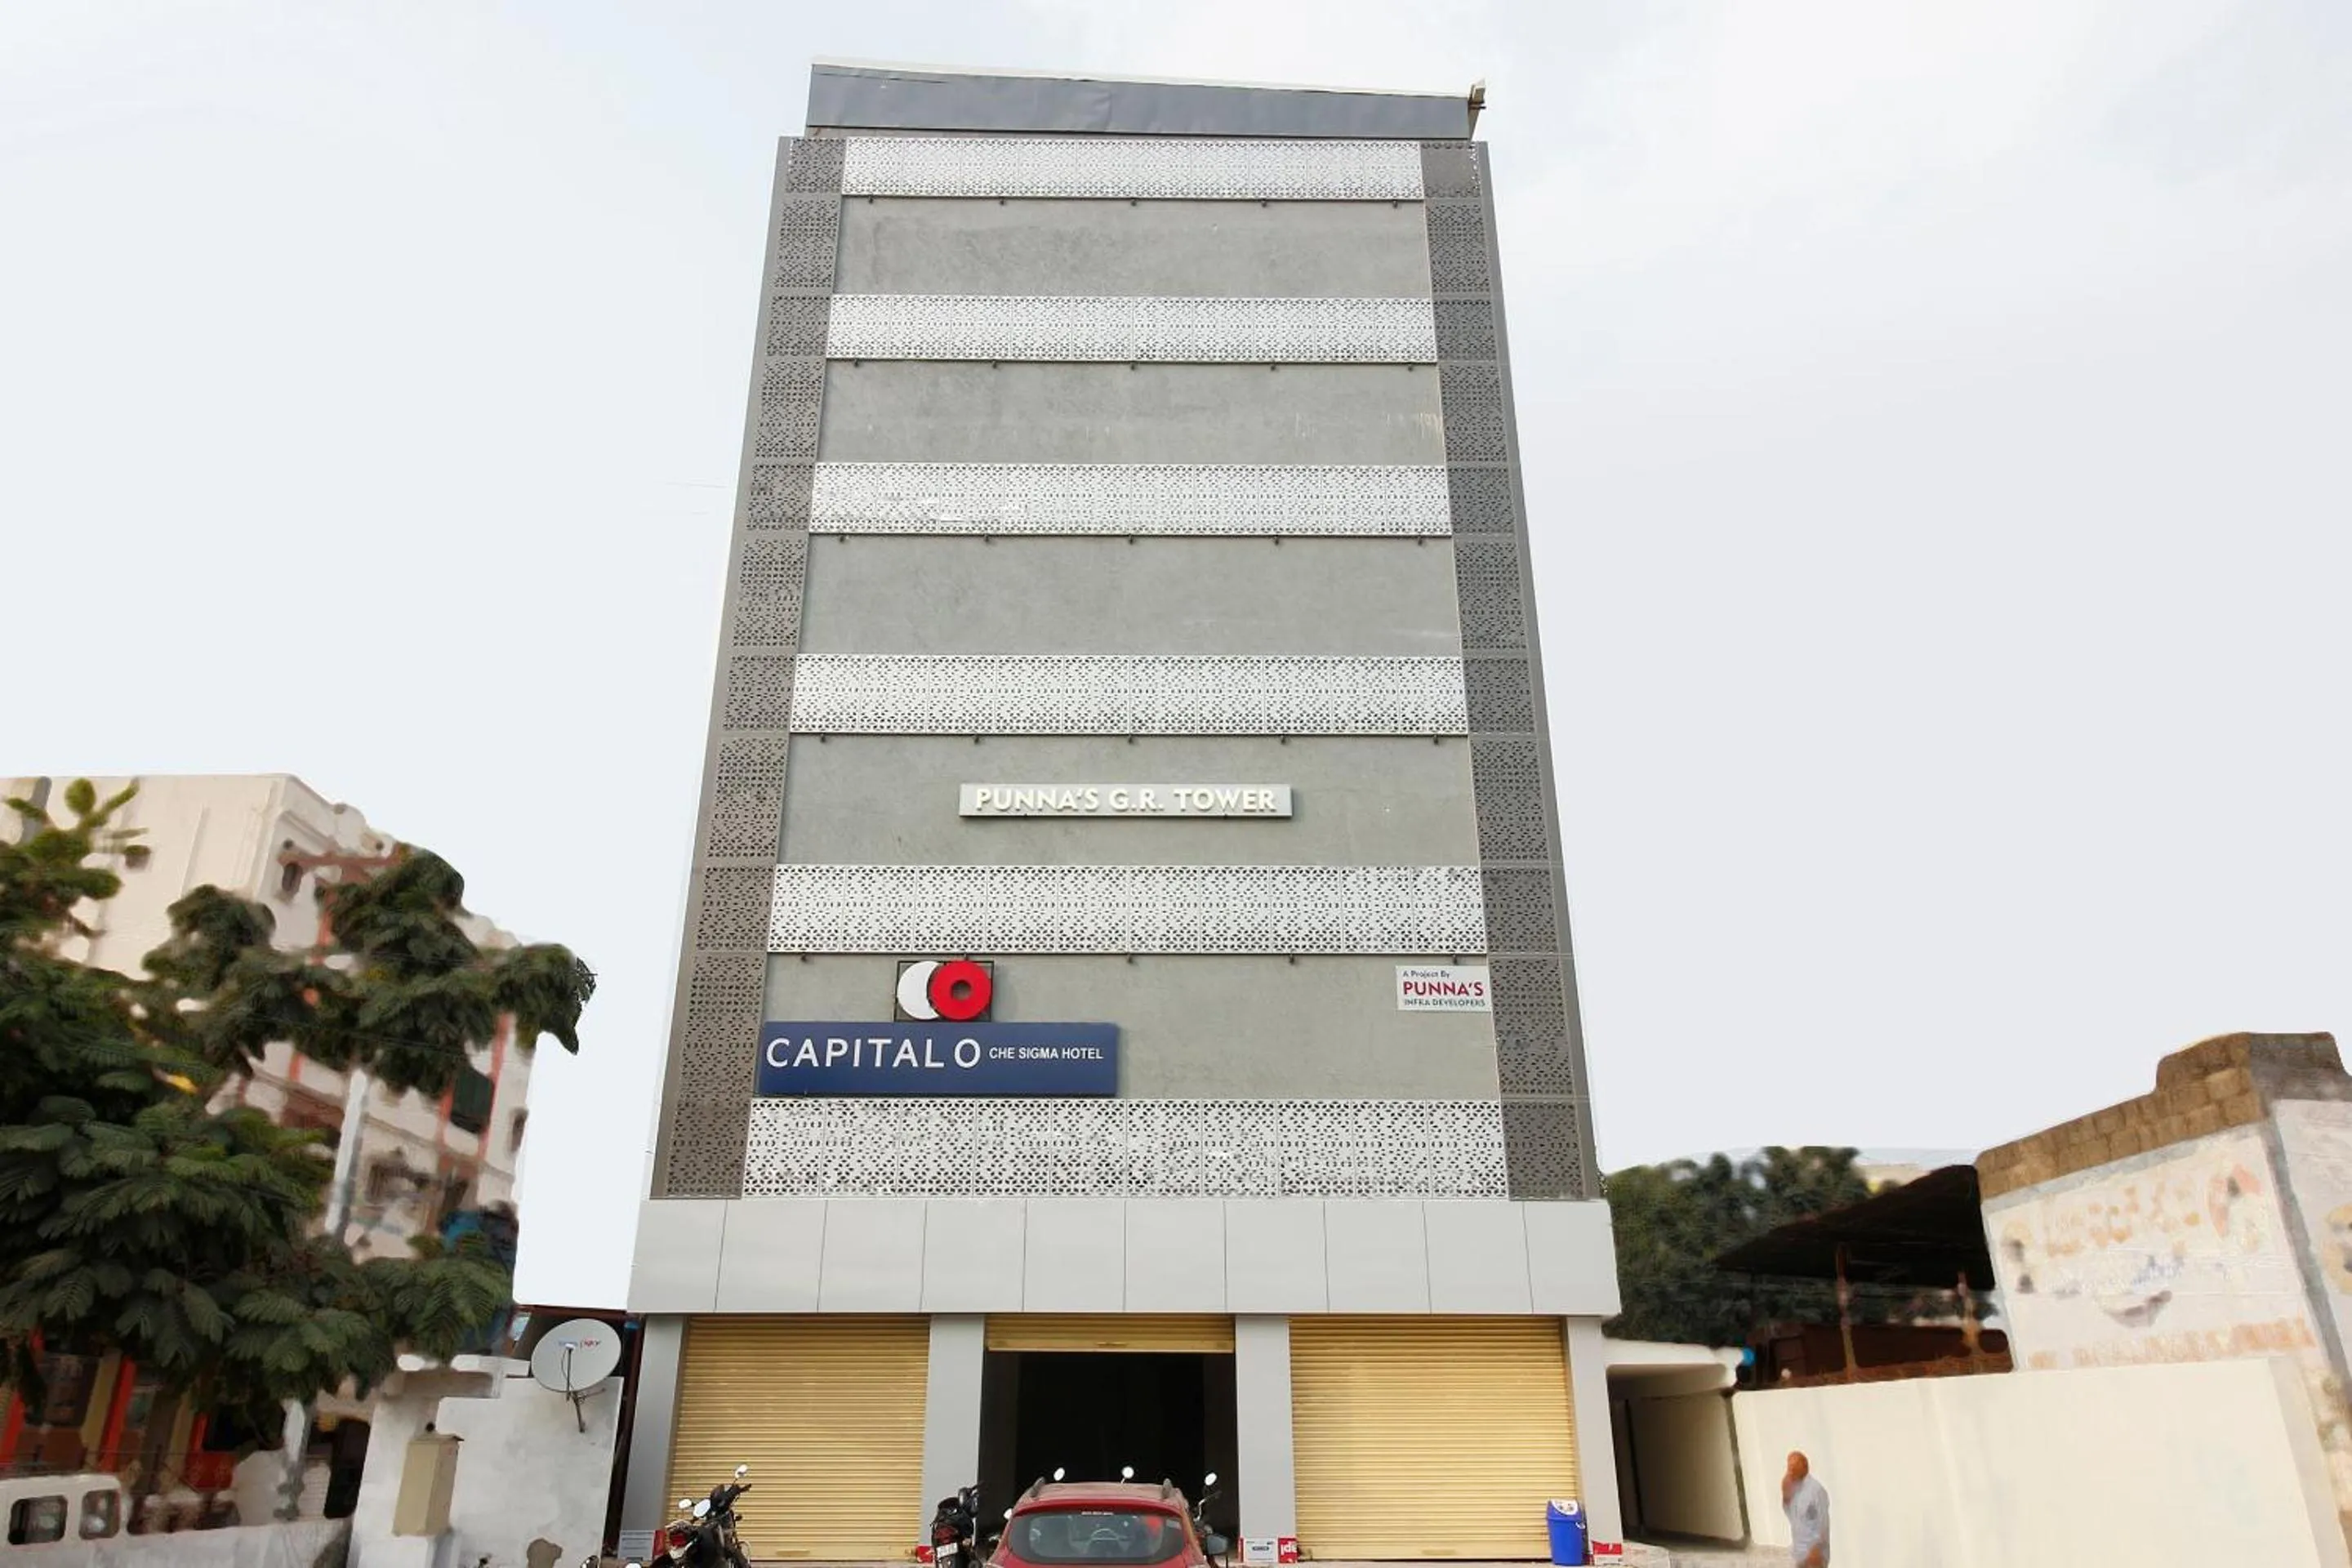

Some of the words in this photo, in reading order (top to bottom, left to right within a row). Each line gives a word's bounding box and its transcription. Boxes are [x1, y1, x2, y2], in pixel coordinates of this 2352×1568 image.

[975, 788, 1099, 811] PUNNA'S
[1108, 788, 1165, 812] G.R.
[1174, 789, 1277, 813] TOWER
[1410, 970, 1438, 978] Project
[1403, 981, 1484, 996] PUNNA'S
[1404, 998, 1431, 1006] INFRA
[1432, 998, 1486, 1007] DEVELOPERS
[765, 1038, 945, 1068] CAPITAL
[954, 1038, 981, 1068] O
[988, 1046, 1015, 1060] CHE
[1018, 1046, 1059, 1060] SIGMA
[1062, 1047, 1104, 1060] HOTEL
